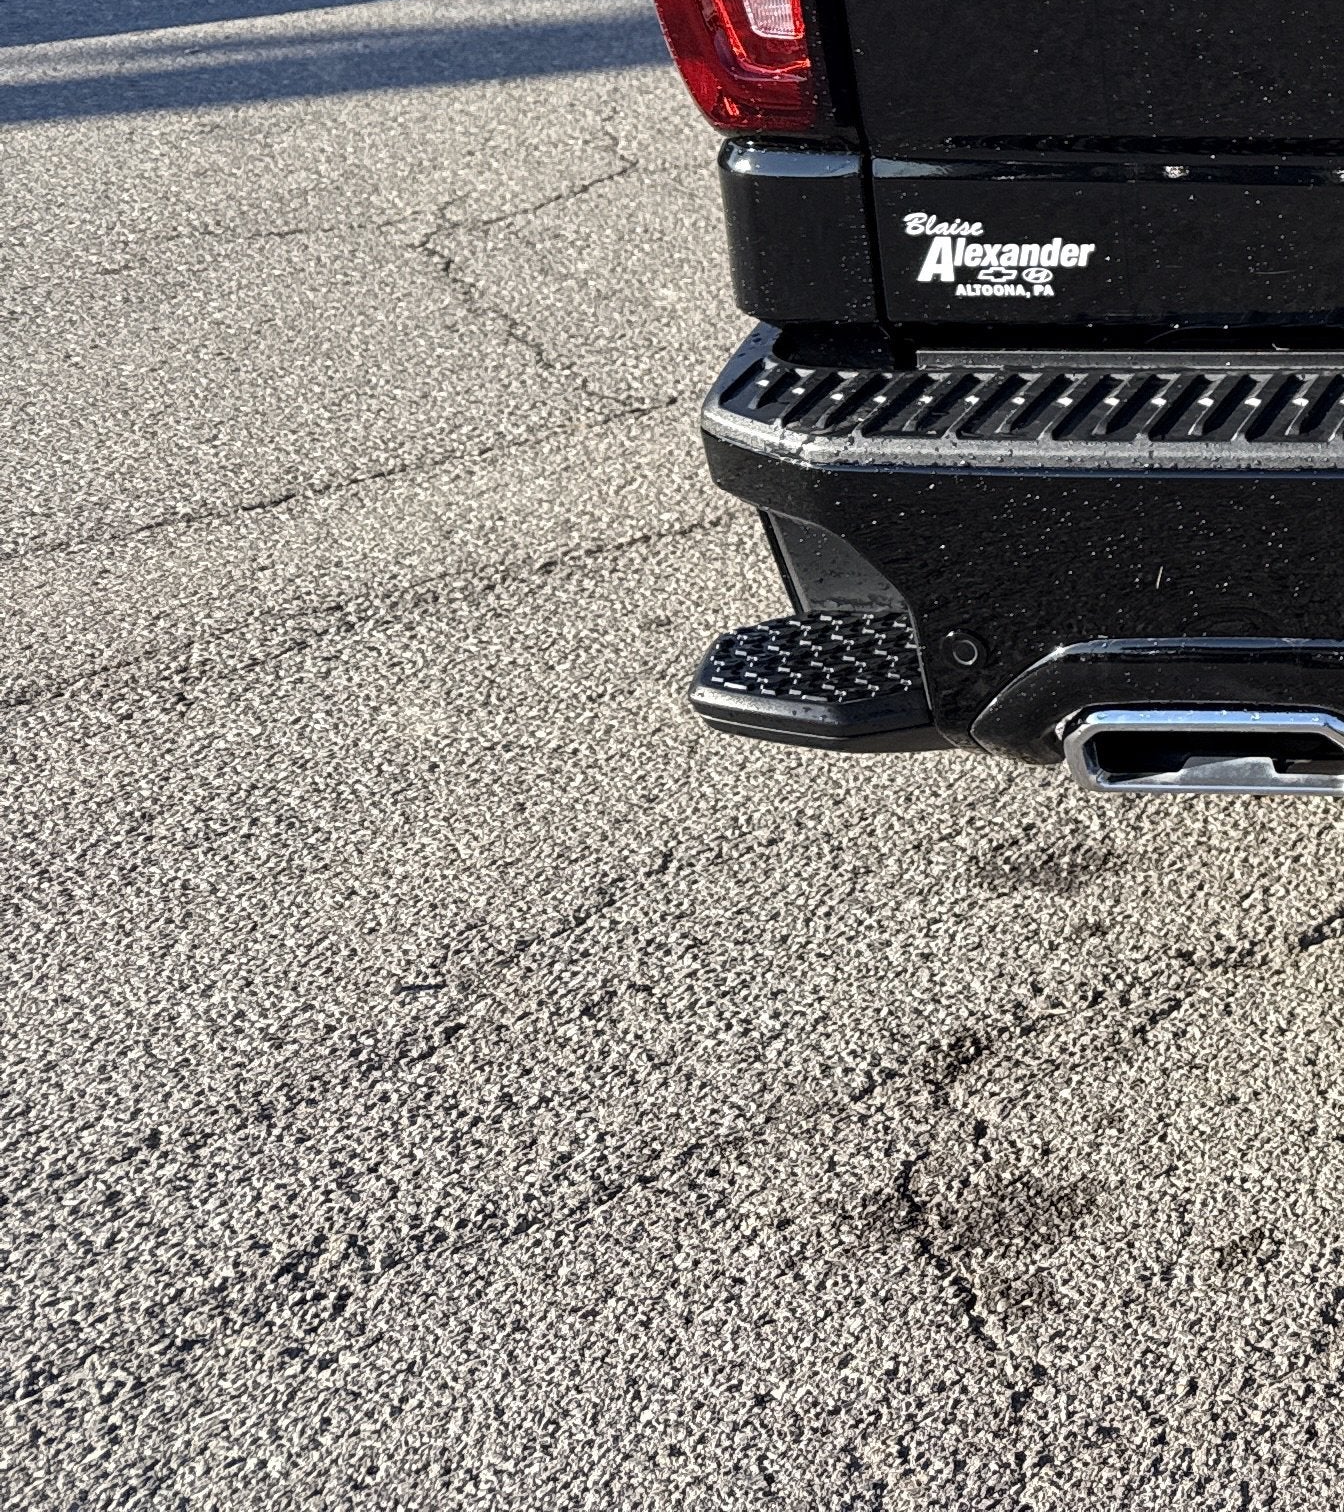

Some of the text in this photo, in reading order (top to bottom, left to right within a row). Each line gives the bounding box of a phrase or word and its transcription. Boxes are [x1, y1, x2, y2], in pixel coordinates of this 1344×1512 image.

[903, 212, 983, 235] Blaise
[917, 236, 1095, 282] Alexander
[955, 284, 1055, 298] ALTOONA, PA
